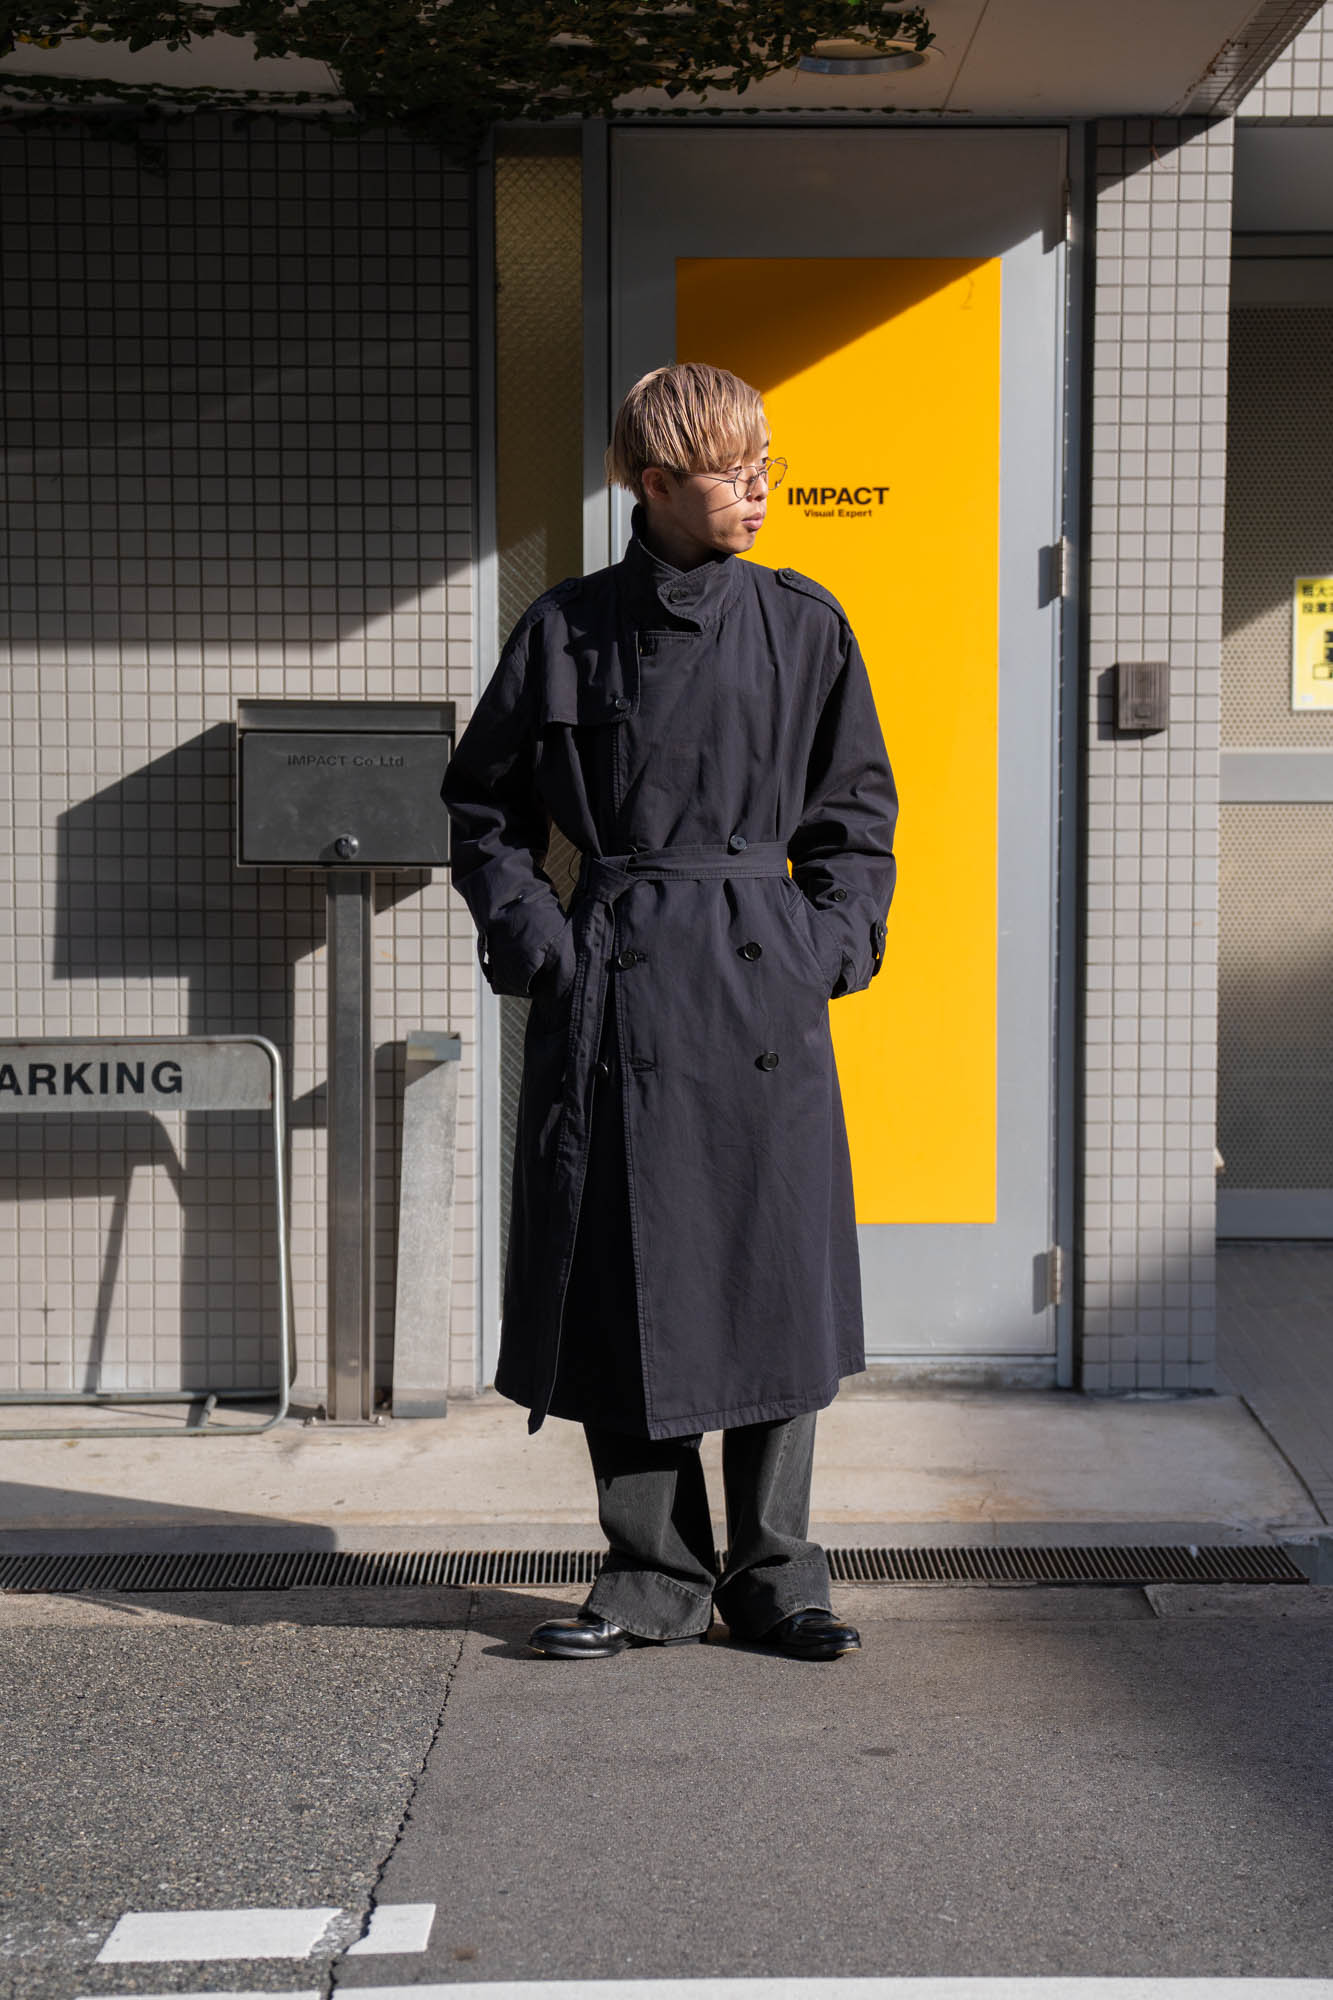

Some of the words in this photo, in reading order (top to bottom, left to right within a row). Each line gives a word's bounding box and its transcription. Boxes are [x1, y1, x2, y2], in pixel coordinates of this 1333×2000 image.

[788, 487, 890, 505] IMPACT
[804, 508, 834, 518] Visual
[838, 508, 872, 519] Expert
[287, 755, 347, 767] IMPACT
